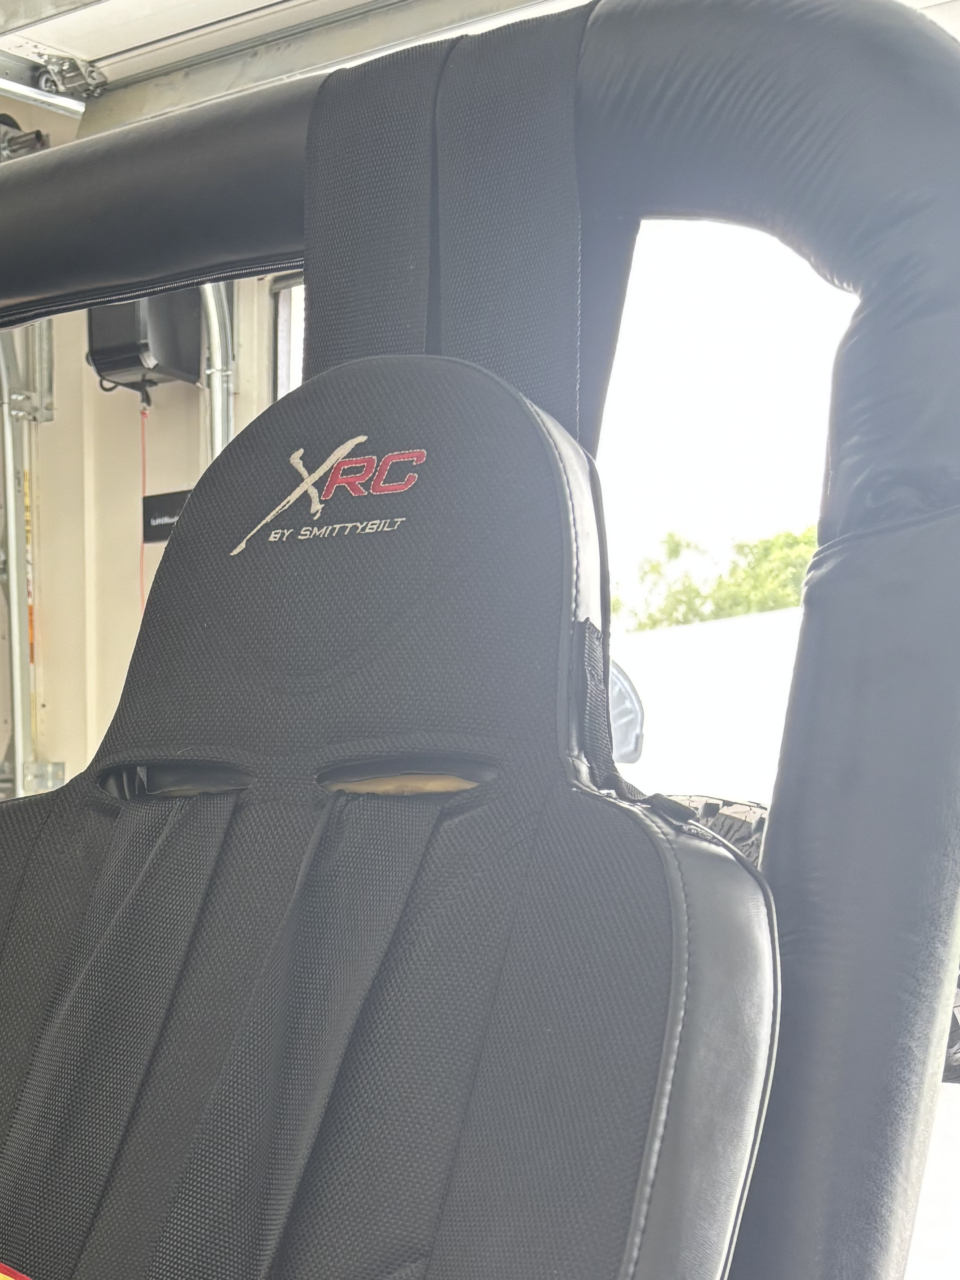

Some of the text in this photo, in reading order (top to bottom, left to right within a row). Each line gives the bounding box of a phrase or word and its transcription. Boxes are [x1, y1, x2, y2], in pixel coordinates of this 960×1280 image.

[230, 435, 427, 556] XRC
[268, 518, 407, 541] BY SMITTYBILT
